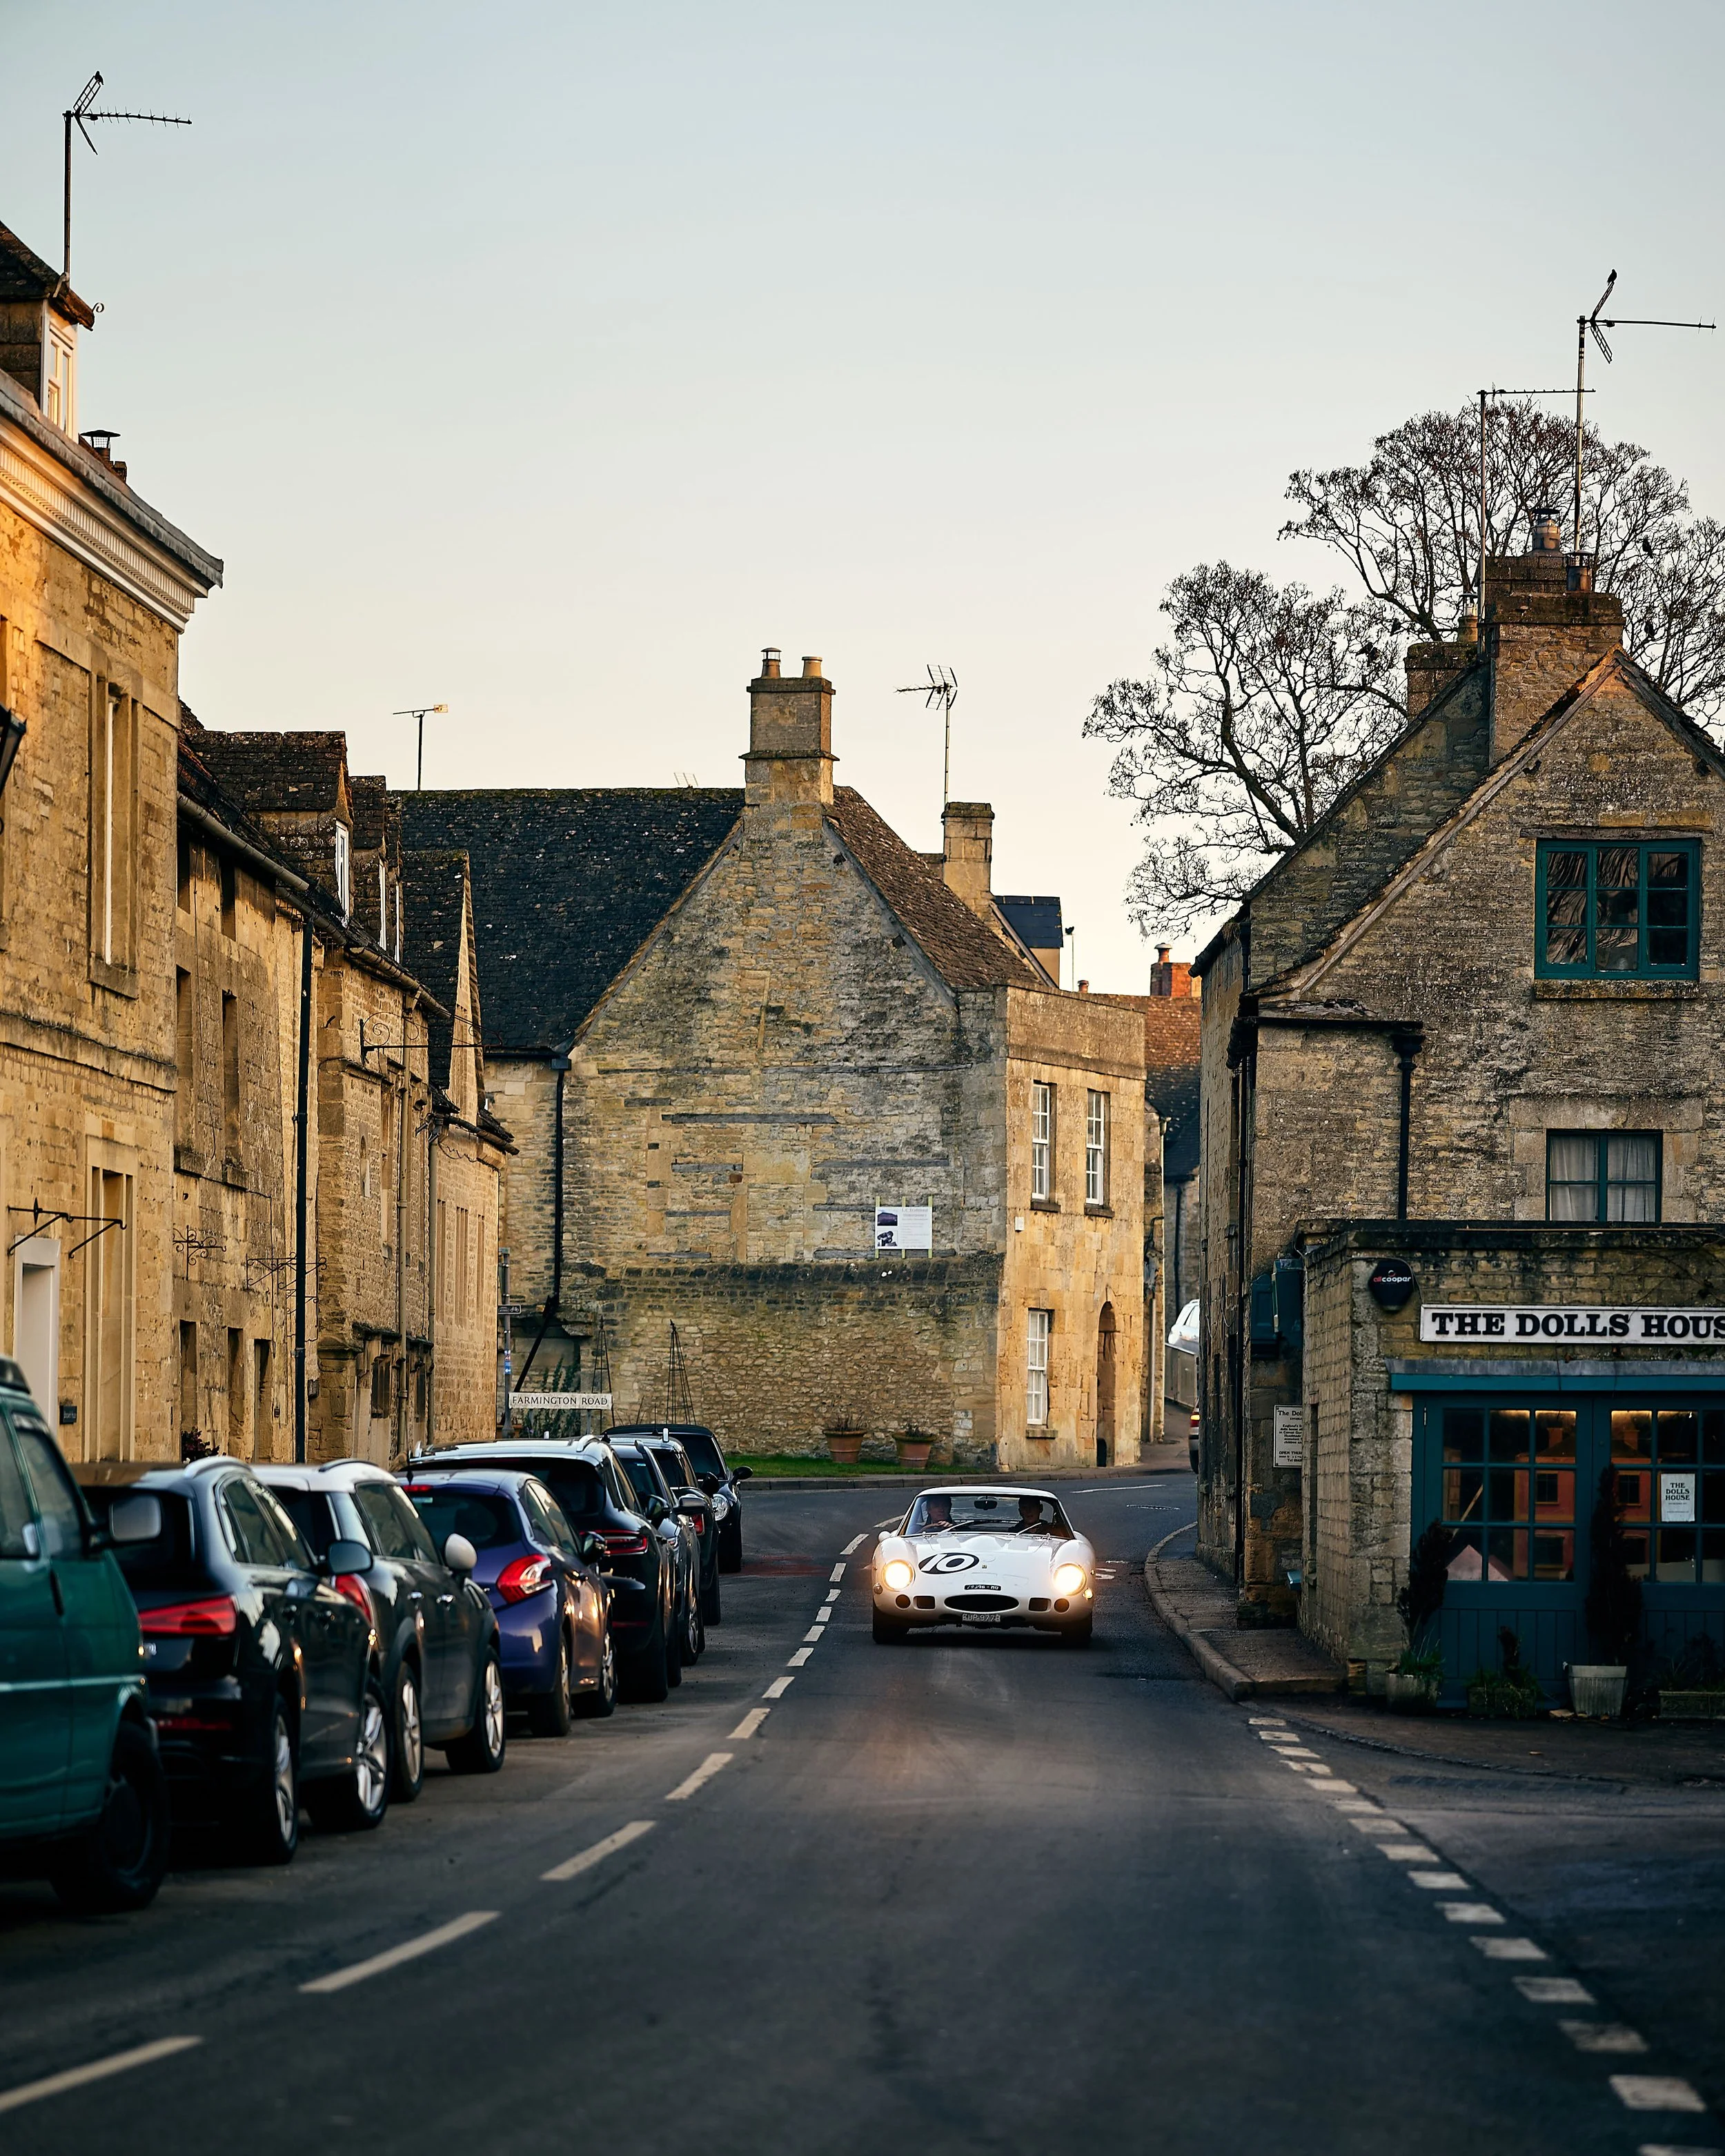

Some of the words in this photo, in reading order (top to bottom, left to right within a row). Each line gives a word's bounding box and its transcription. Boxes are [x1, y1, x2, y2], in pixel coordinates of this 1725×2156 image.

[1432, 1313, 1505, 1336] THE
[1515, 1314, 1630, 1337] DOLLS
[1641, 1314, 1725, 1338] HOUS
[513, 1396, 577, 1405] FARMINGTON
[582, 1397, 608, 1405] ROAD
[920, 1554, 974, 1572] 10
